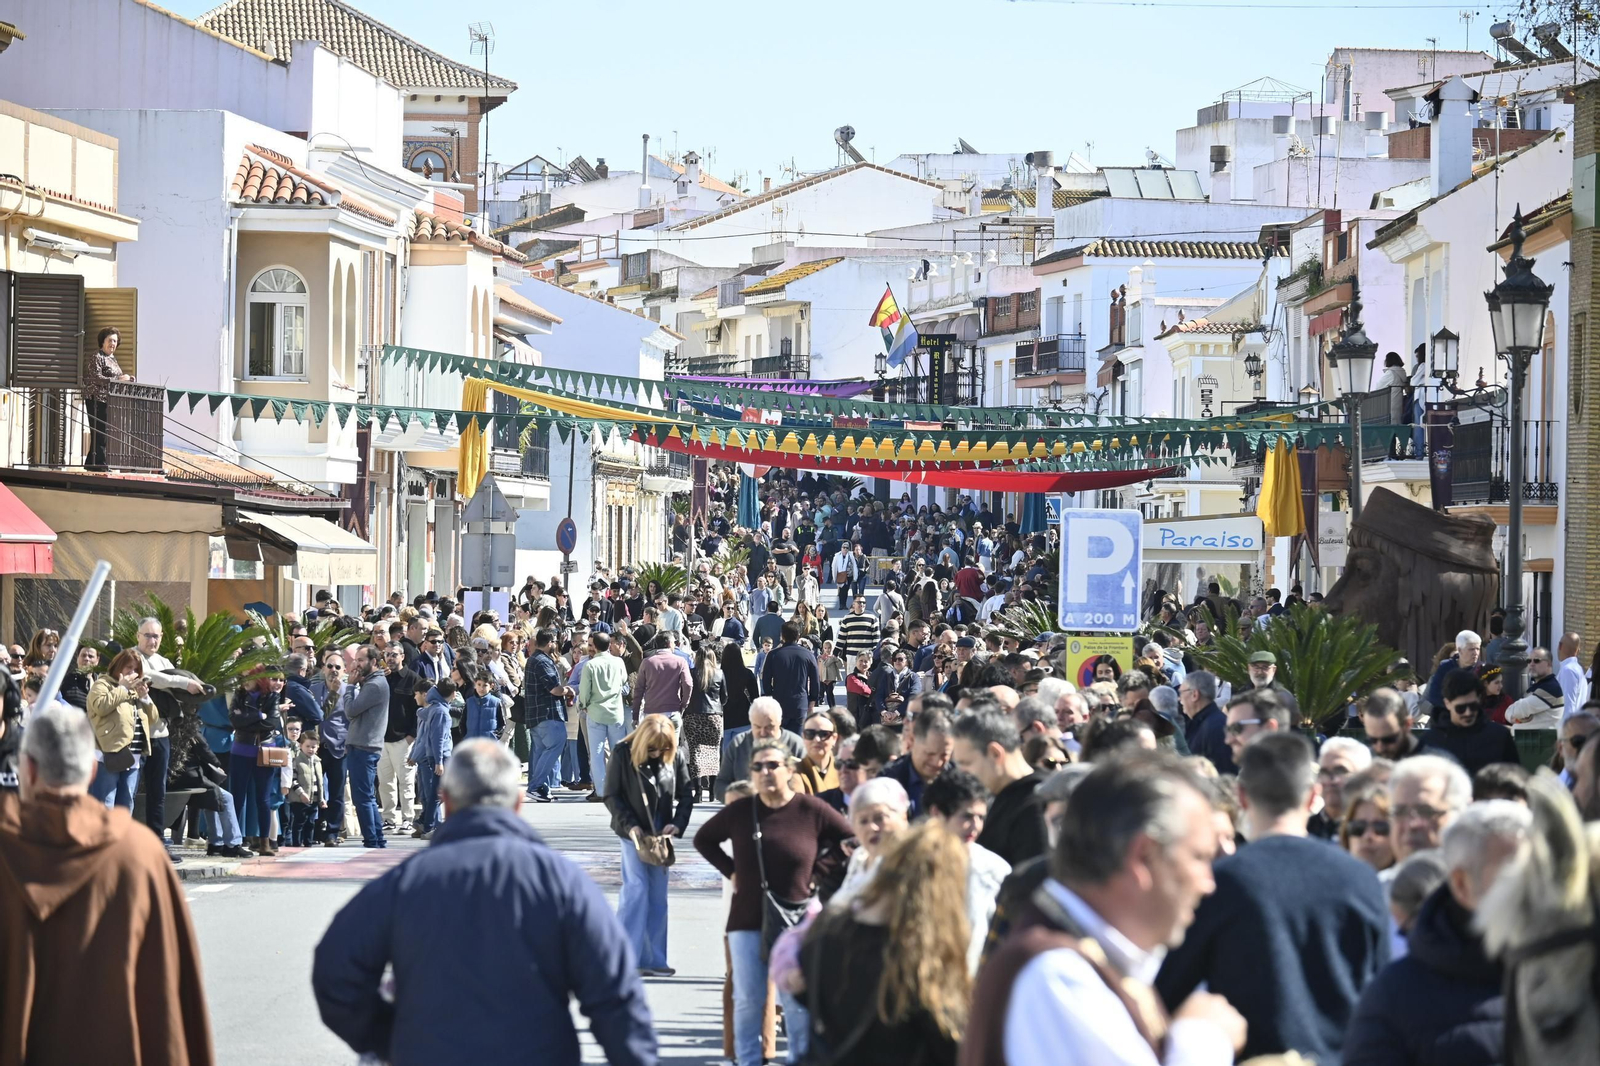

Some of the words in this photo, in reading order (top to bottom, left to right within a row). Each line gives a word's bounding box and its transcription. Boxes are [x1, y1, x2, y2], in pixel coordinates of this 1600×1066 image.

[920, 336, 939, 346] Hotel
[1160, 528, 1253, 548] Paraiso
[1067, 518, 1134, 603] P
[1064, 613, 1074, 624] A
[1084, 613, 1114, 625] 200
[1123, 614, 1135, 625] M
